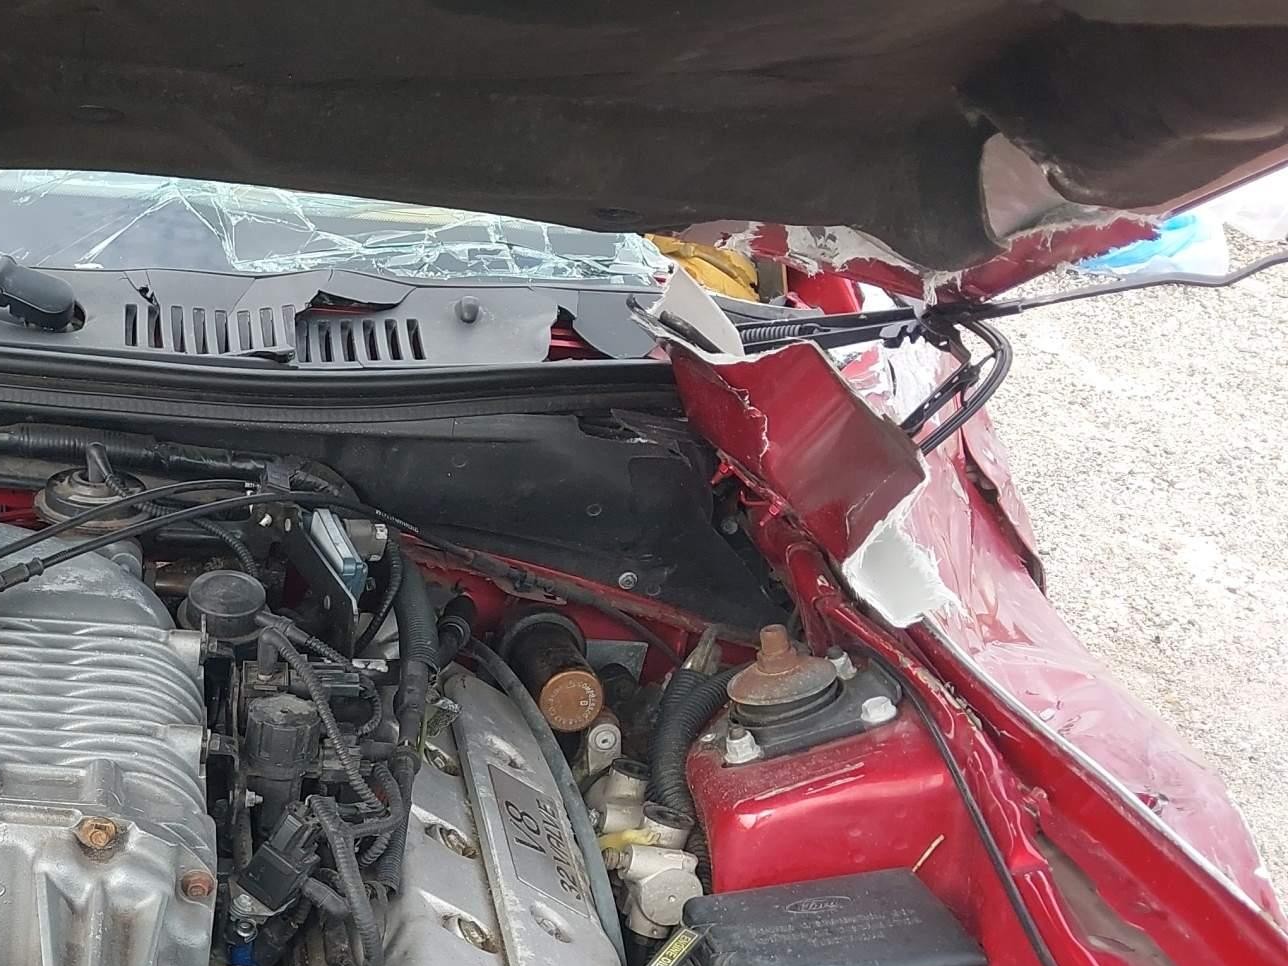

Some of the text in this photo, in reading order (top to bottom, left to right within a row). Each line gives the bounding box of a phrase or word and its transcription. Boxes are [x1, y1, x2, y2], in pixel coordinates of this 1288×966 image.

[504, 800, 547, 854] V8
[535, 798, 571, 866] VALVE
[667, 934, 692, 958] ENGINE
